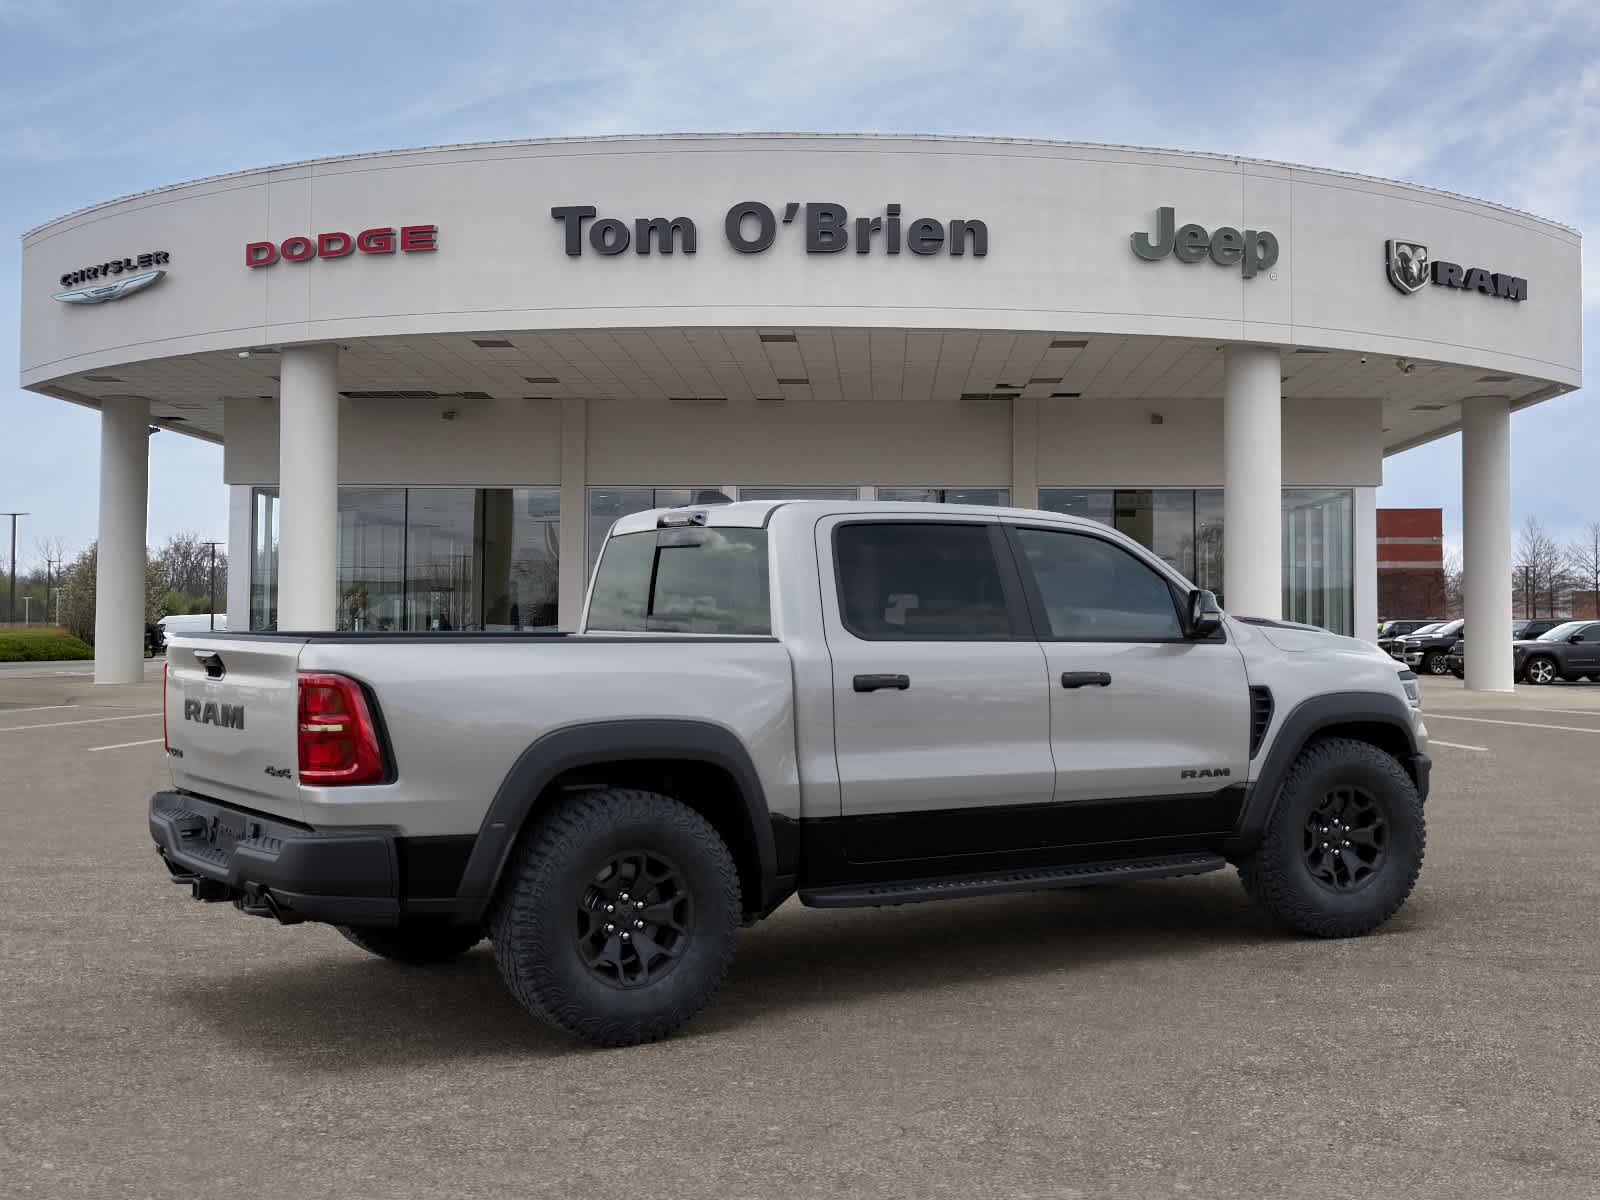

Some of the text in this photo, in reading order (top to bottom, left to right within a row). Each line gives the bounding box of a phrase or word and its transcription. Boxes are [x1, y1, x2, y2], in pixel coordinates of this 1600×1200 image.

[246, 225, 438, 268] DODGE
[551, 200, 988, 256] Tom O'Brien
[1131, 207, 1279, 279] Jeep
[61, 251, 170, 287] CHRYSLER
[1431, 261, 1528, 301] RAM
[184, 699, 245, 730] RAM
[1181, 768, 1230, 779] RAM
